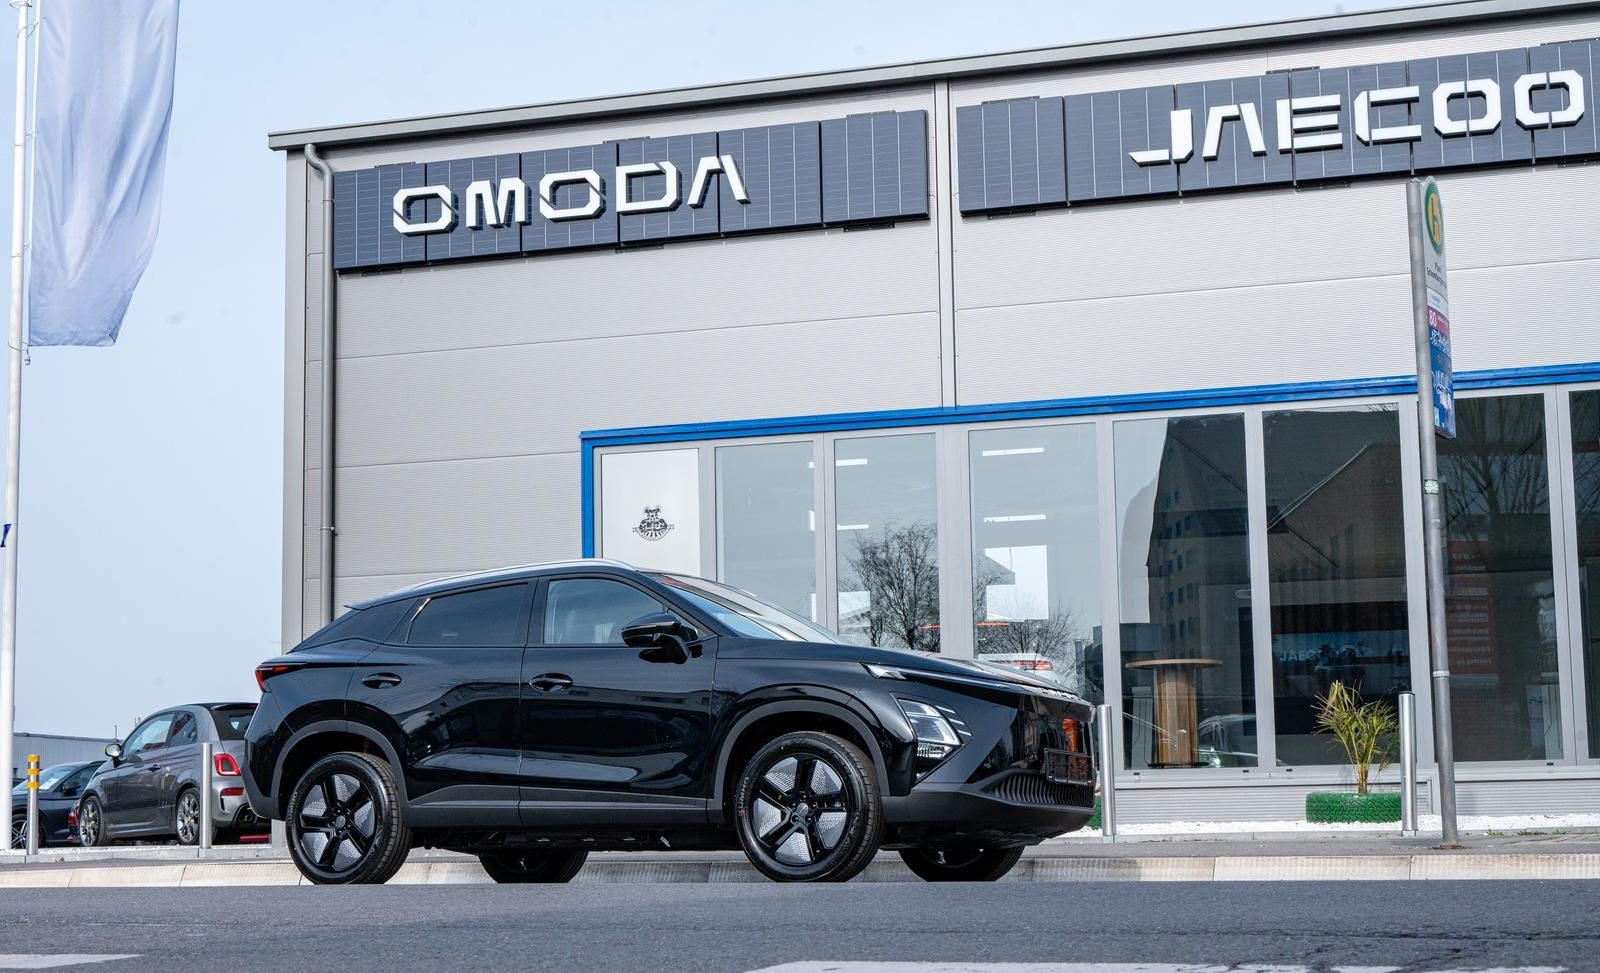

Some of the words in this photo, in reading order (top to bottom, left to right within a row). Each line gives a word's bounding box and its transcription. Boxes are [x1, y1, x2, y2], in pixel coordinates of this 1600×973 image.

[1129, 70, 1585, 167] JAECOO
[392, 154, 751, 235] OMODA
[1428, 308, 1437, 327] 80
[1279, 648, 1321, 662] JAEC
[737, 776, 750, 817] KUMHO
